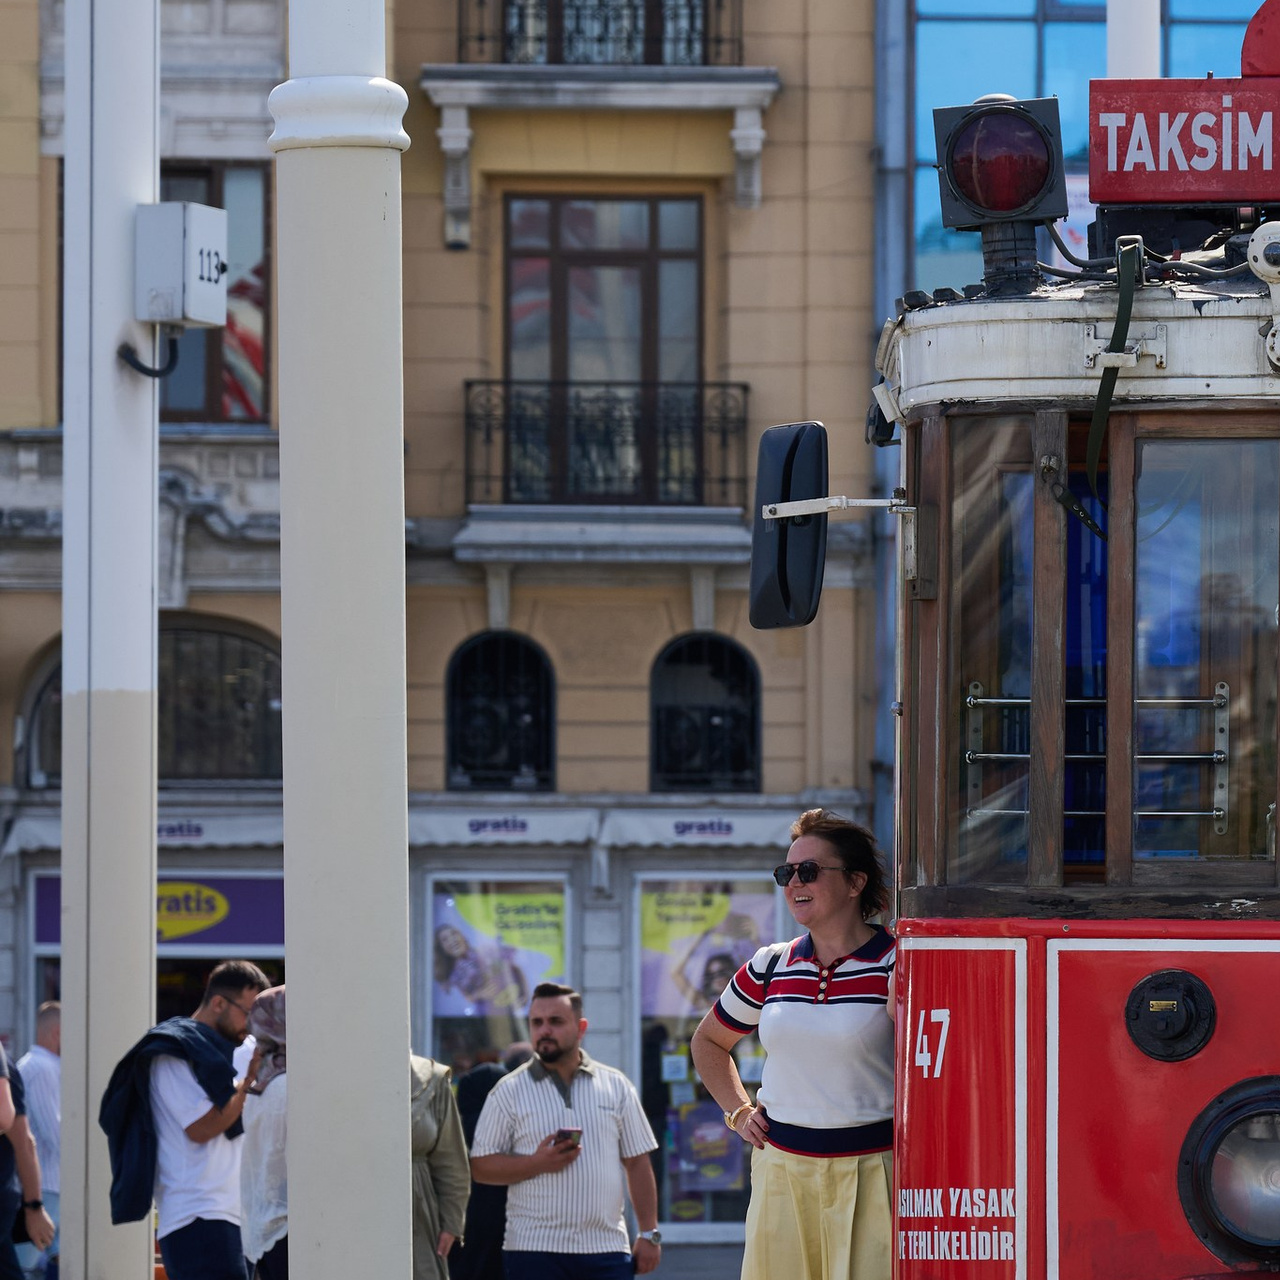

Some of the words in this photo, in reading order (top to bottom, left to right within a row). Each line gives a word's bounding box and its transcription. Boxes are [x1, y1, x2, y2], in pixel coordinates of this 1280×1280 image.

[1098, 94, 1274, 172] TAKSİM
[199, 248, 221, 285] 113
[157, 820, 204, 837] ratis
[468, 815, 529, 835] gratis
[674, 817, 733, 837] gratis
[157, 888, 217, 913] ratis
[915, 1008, 950, 1078] 47
[949, 1187, 1016, 1218] YASAK
[908, 1225, 1014, 1261] TEHLİKELİDİR
